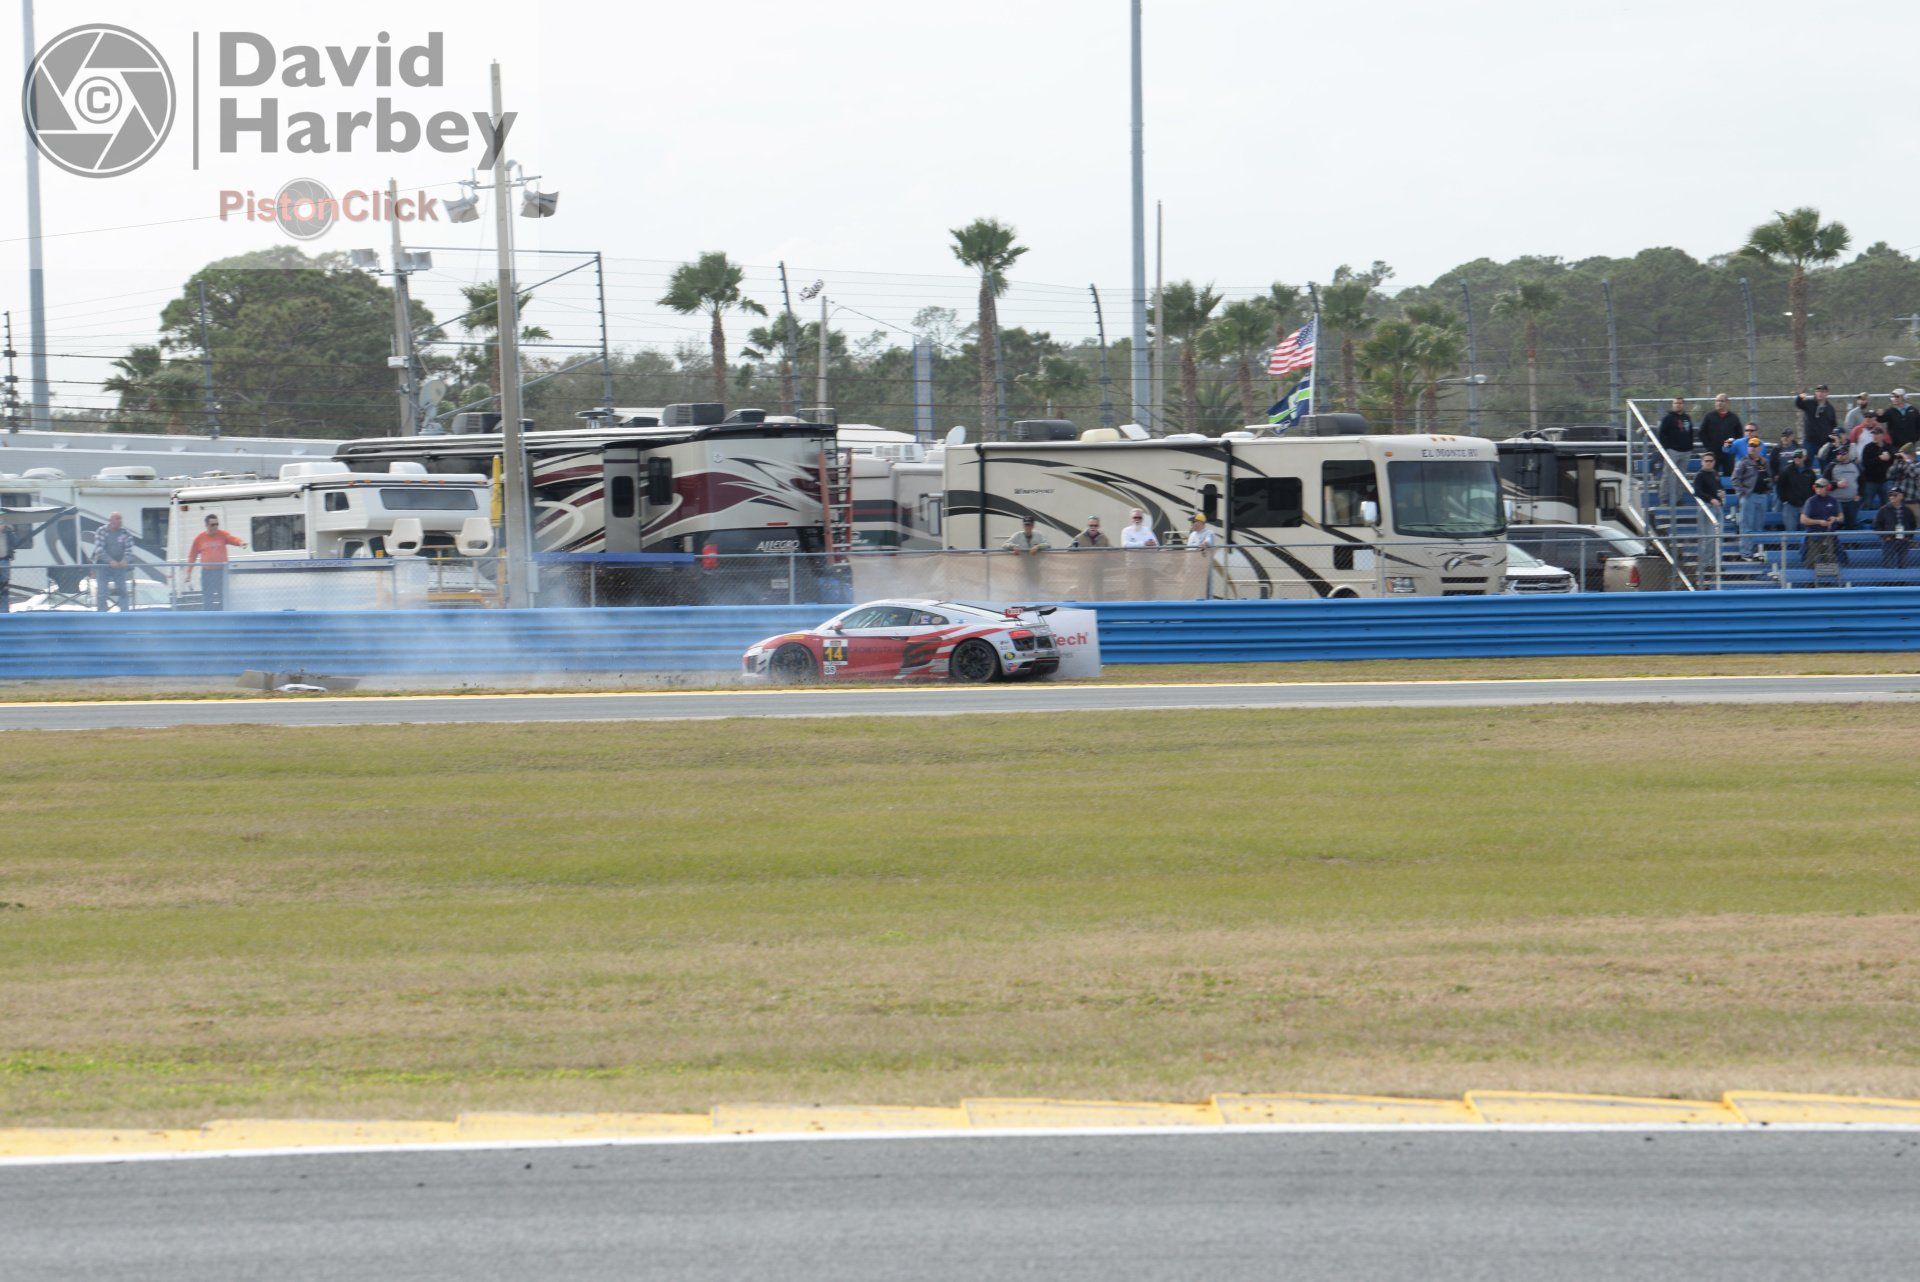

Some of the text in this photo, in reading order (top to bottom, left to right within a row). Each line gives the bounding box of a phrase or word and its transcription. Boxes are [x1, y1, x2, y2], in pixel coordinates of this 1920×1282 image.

[1422, 449, 1434, 457] EL
[755, 540, 800, 550] ALLEGRO
[825, 645, 843, 661] 14
